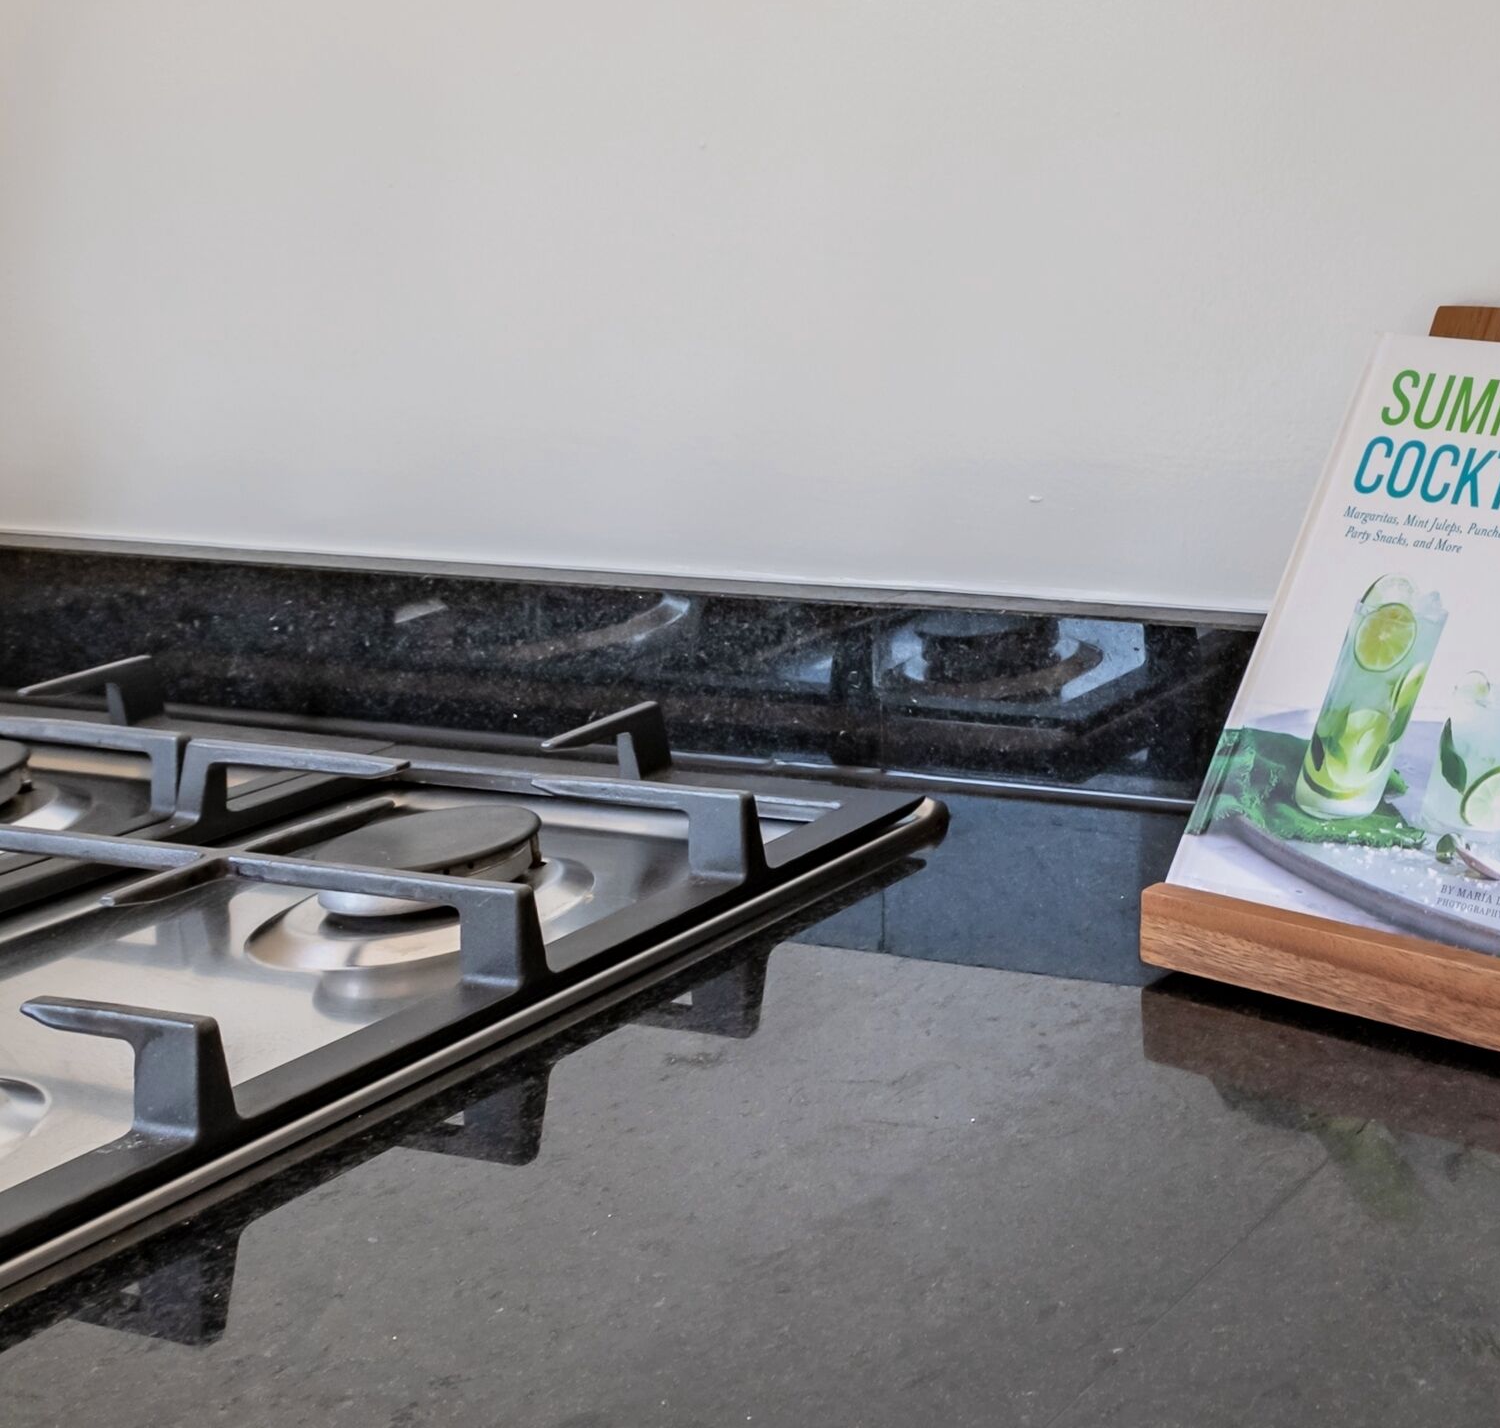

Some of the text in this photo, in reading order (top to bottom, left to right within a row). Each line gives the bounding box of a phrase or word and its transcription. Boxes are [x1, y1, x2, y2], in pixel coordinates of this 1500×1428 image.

[1343, 505, 1400, 525] Margaritas,
[1403, 514, 1429, 528] Mint
[1427, 518, 1463, 536] Juleps,
[1345, 526, 1463, 553] Party Snacks, and More
[1440, 884, 1455, 893] BY
